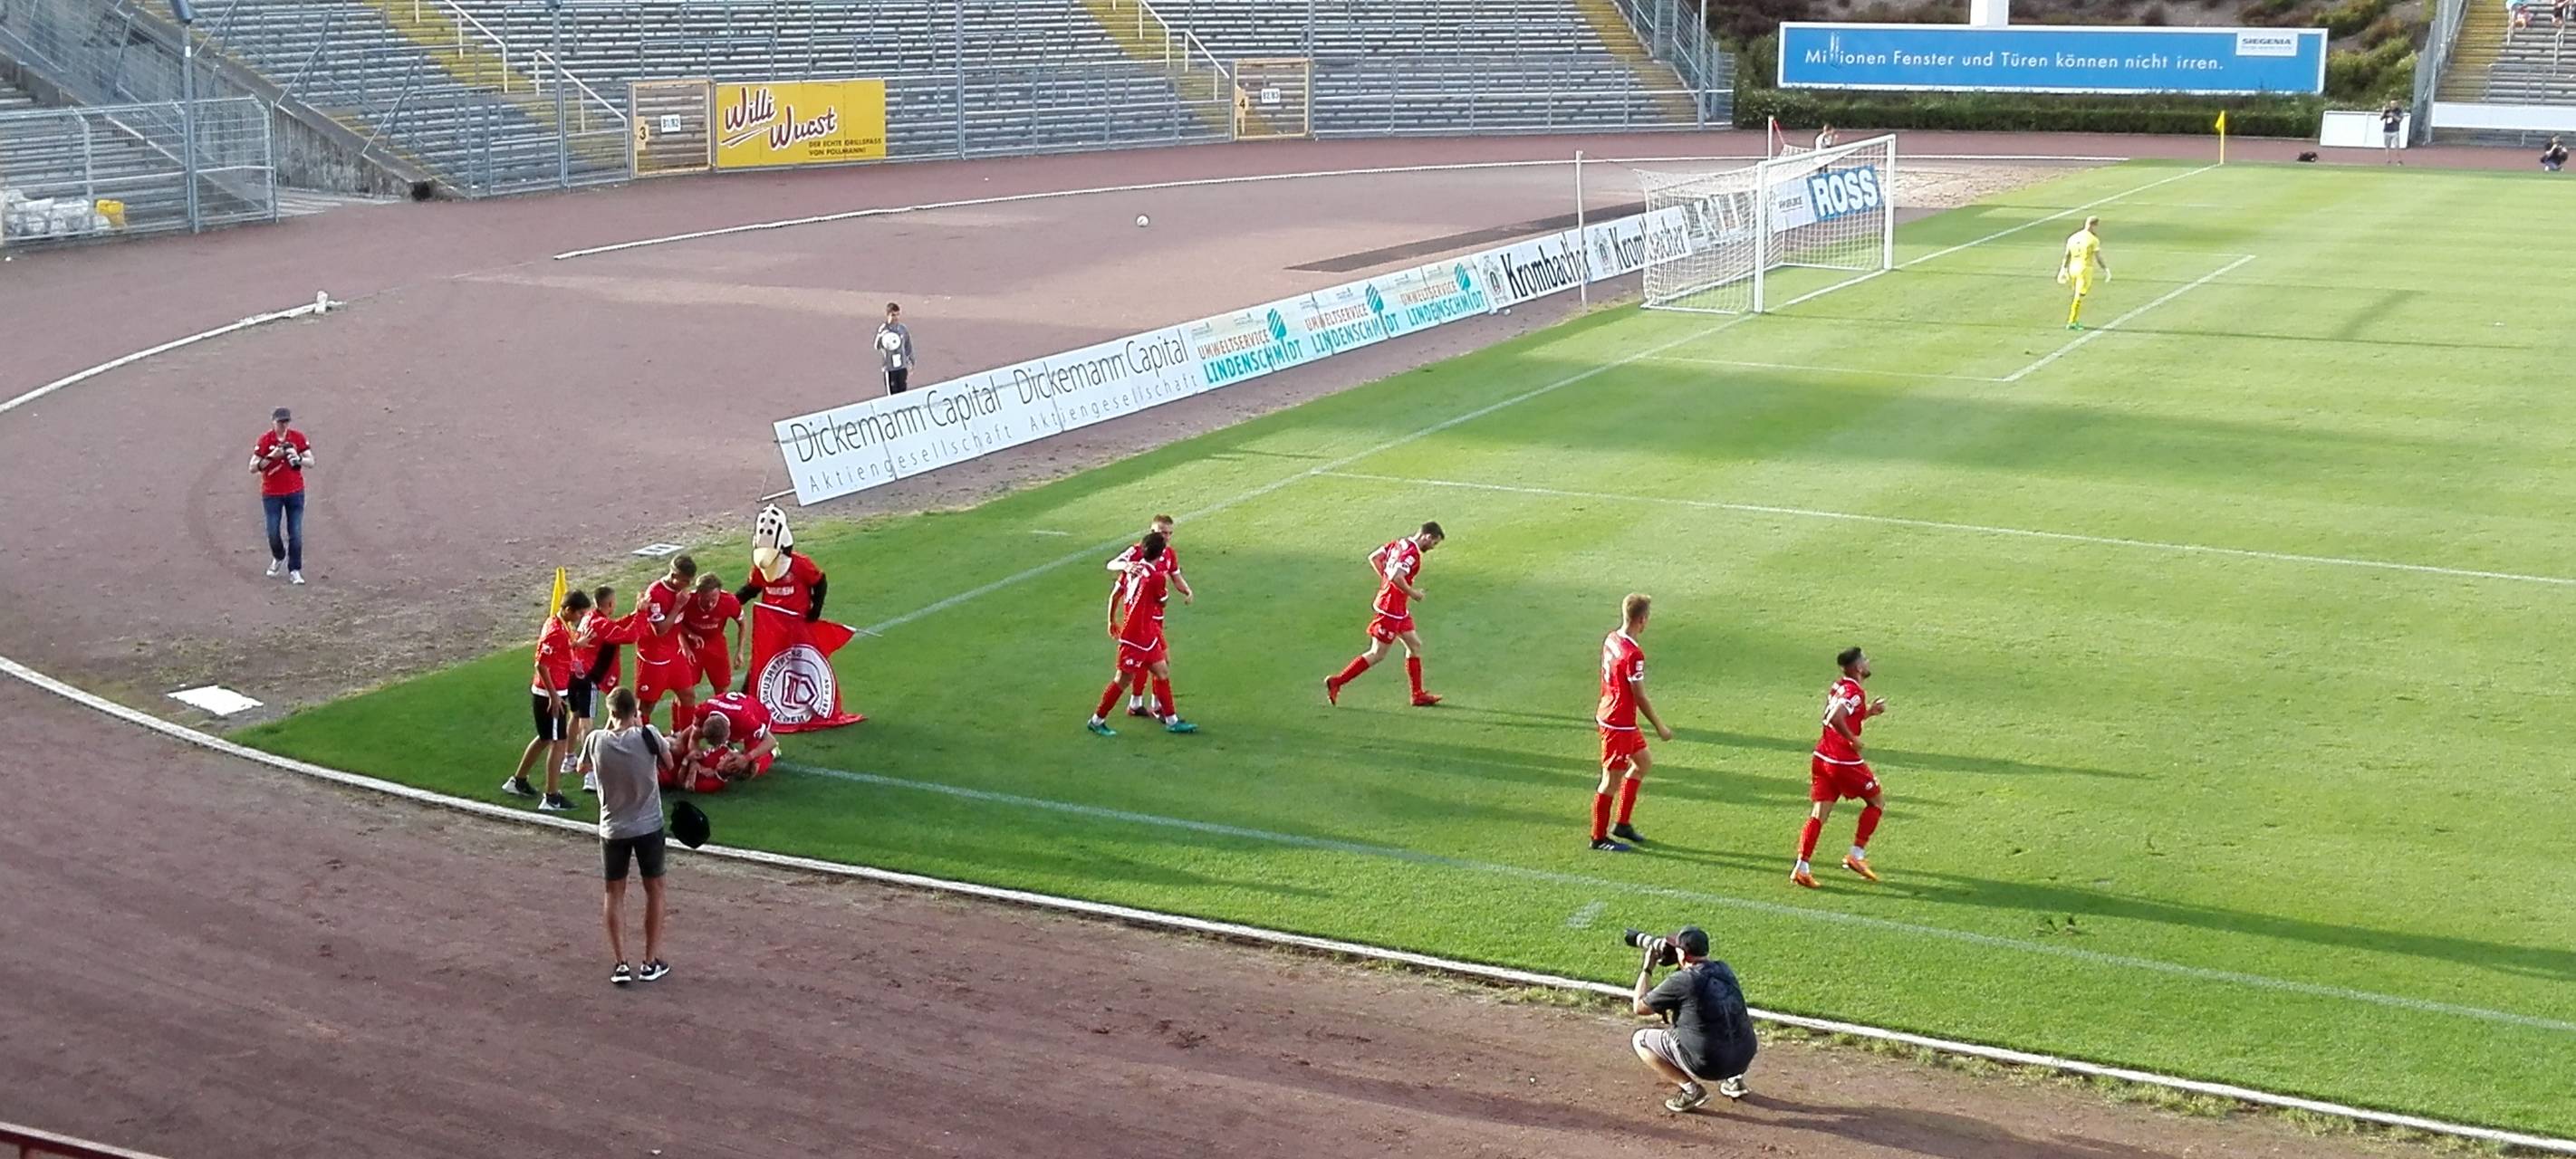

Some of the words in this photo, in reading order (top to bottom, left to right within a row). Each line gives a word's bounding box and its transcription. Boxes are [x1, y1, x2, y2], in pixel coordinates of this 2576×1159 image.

[1893, 51, 1954, 65] Fenster
[1962, 52, 1994, 66] und
[2001, 52, 2049, 67] Türen
[2055, 53, 2119, 69] können
[2125, 53, 2167, 69] nicht
[2177, 55, 2225, 70] irren.
[726, 87, 775, 129] Willi
[1239, 98, 1245, 109] 4
[639, 126, 647, 140] 3
[1812, 169, 1878, 216] ROSS
[1609, 216, 1687, 270] Krombacher
[1500, 239, 1592, 300] Krombacher
[1399, 281, 1457, 306] UMWELTSERVICE
[1406, 290, 1485, 327] LINDENSCHMIDT
[1304, 303, 1369, 331] UMWELTSERVICE
[1311, 311, 1399, 353] LINDENSCHMIDT
[1197, 329, 1270, 359] UMWELTSERVICE
[1204, 339, 1303, 384] LINDENSCHMIDT
[1013, 353, 1127, 405] Dickemann
[1126, 329, 1189, 378] Capital
[790, 405, 927, 463] Dickemann
[927, 375, 1003, 431] Capital
[1029, 373, 1198, 432] Aktiengesellschaft
[810, 424, 1013, 493] Aktiengesellschaft
